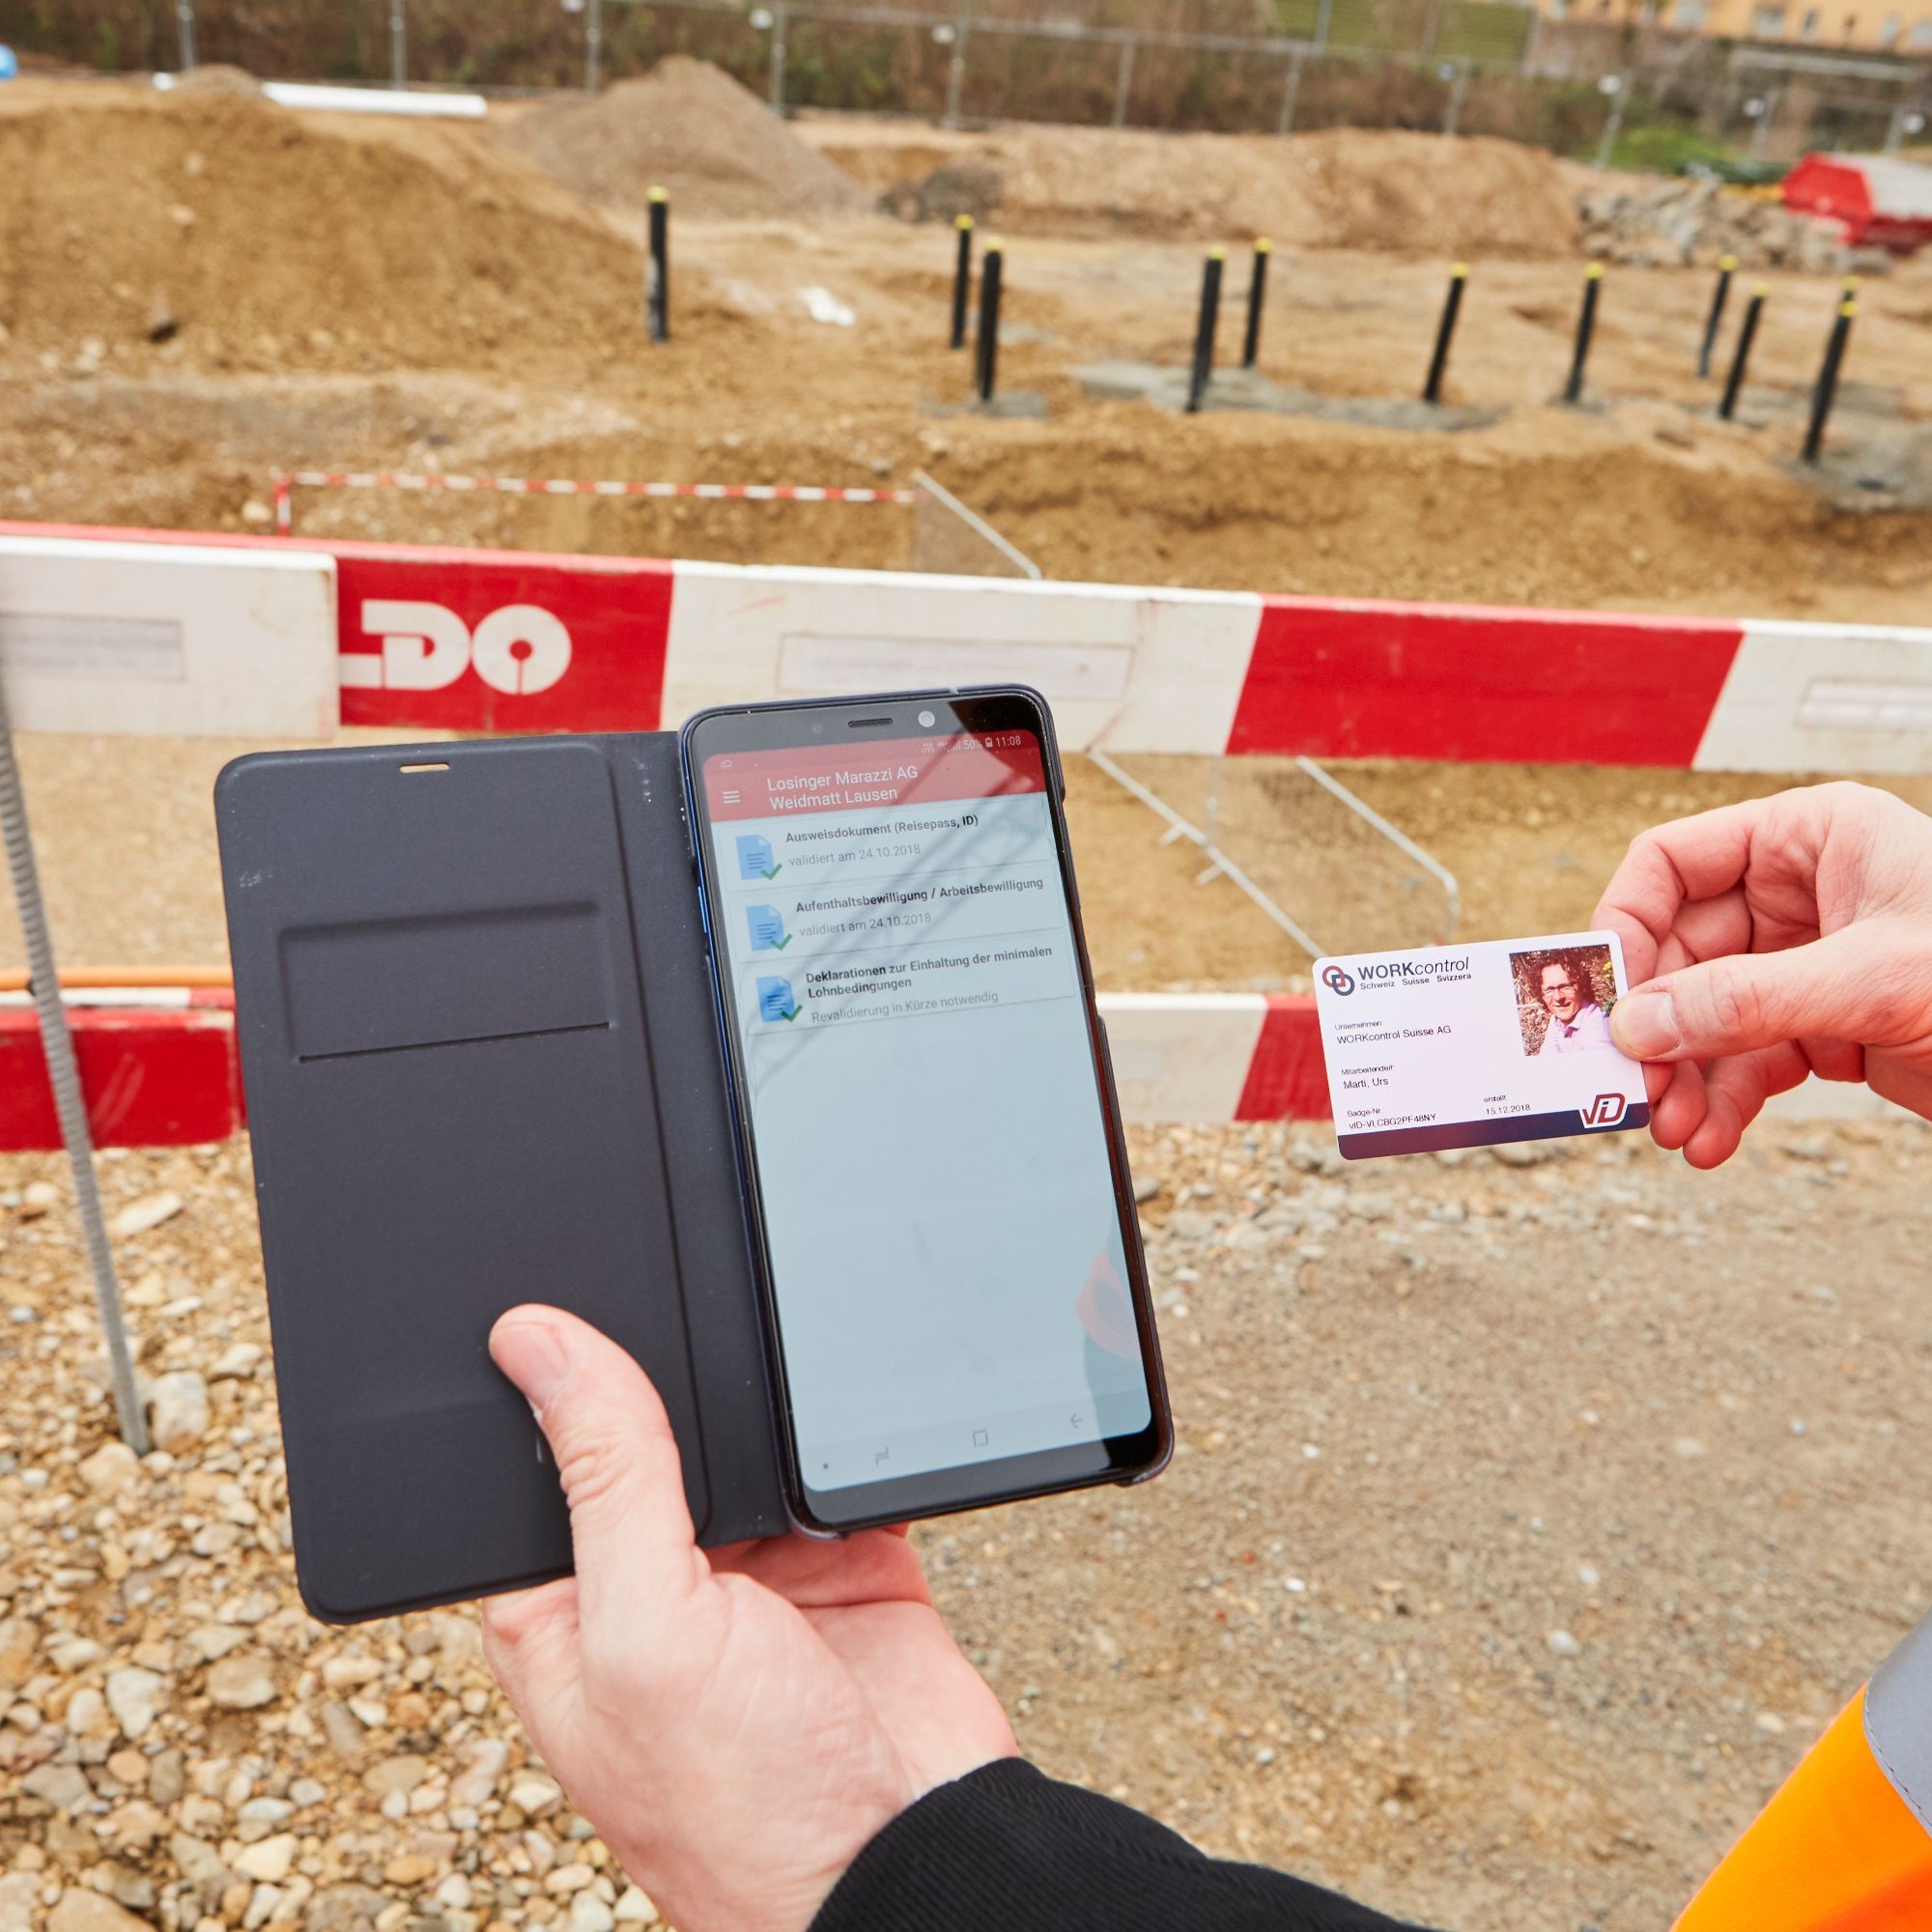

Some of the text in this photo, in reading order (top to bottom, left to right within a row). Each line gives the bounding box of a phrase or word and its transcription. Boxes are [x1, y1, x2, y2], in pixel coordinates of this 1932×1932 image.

[995, 735, 1021, 747] 11:08
[766, 765, 918, 791] Losinger Marazzi AG
[769, 788, 897, 810] Weidmatt Lausen
[785, 814, 979, 843] Ausweisdokument (Reisepass, ID)
[788, 843, 922, 867] validiert am 24.10.2018
[796, 878, 1043, 913] Aufenthaltsbewilligung / Arbeitsbewilligung
[799, 913, 931, 936] validiert am 24.10.2018
[806, 946, 1052, 983] Deklarationen zur Einhaltung der minimalen
[1357, 956, 1469, 980] WORKcontrol
[808, 978, 912, 999] Lohnbedingungen
[1360, 974, 1471, 990] Schweiz Suisse Svizzera
[811, 990, 999, 1023] Revalidierung in Kürze notwendig
[1335, 1020, 1382, 1031] Unternehmen
[1337, 1025, 1452, 1044] WORKcontrol Suisse AG
[1344, 1077, 1389, 1090] Marti, Urs
[1483, 1094, 1506, 1103] erstellt
[1486, 1104, 1531, 1115] 15.12.2018
